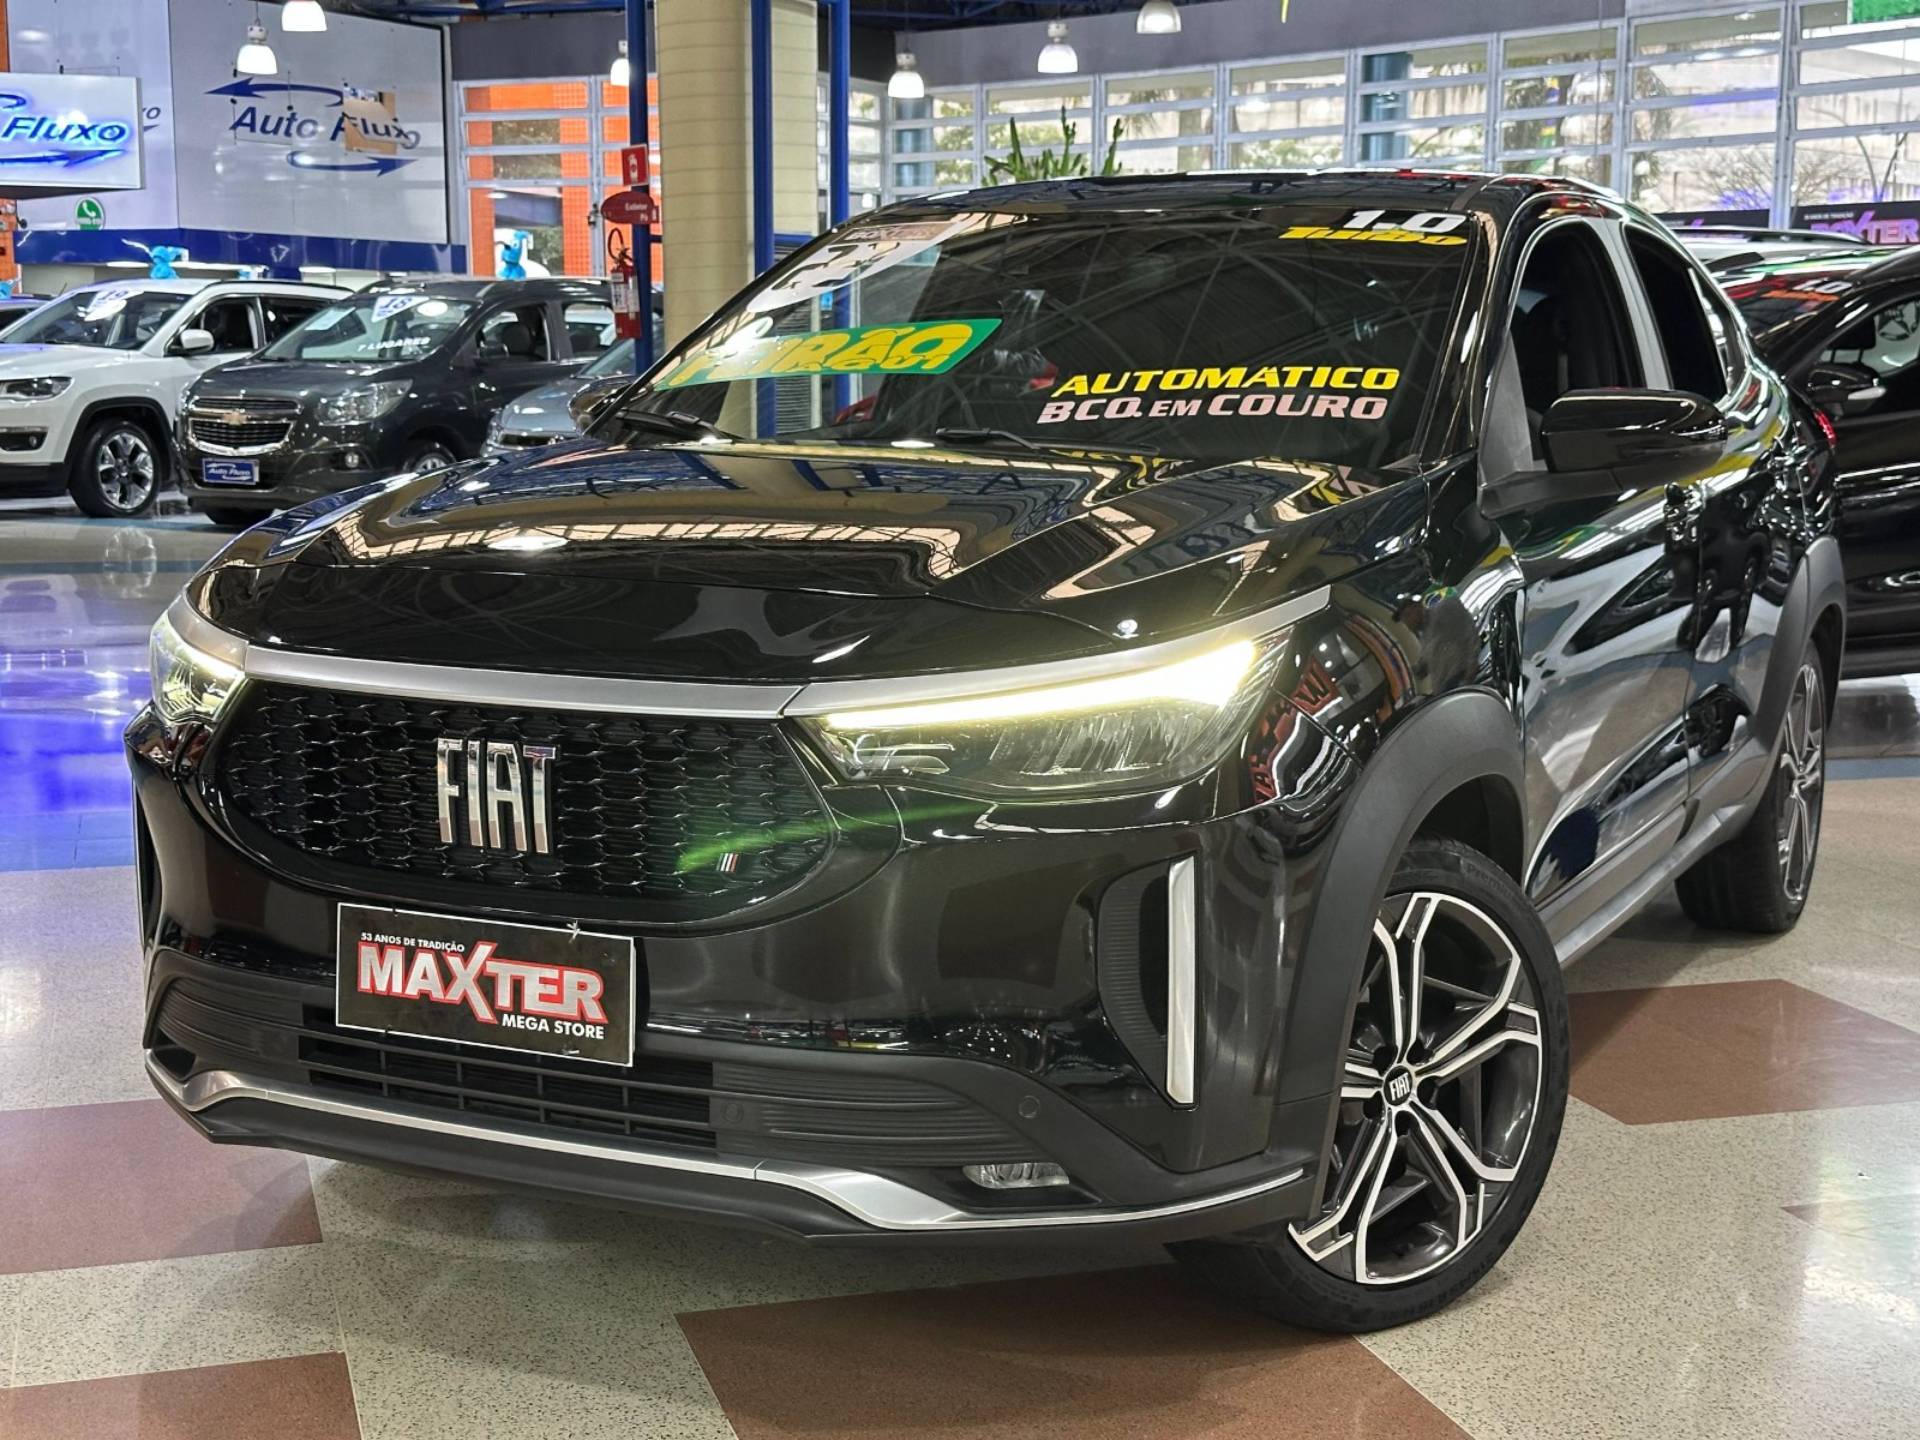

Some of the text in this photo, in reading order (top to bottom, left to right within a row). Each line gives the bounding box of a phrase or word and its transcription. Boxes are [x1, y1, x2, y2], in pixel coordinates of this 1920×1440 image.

[1, 116, 126, 141] Fluxo
[228, 106, 421, 150] Auto Fluxo
[1343, 209, 1467, 233] 1.0
[1149, 399, 1202, 417] EM
[1207, 394, 1389, 420] COURO
[437, 737, 556, 854] FIAT
[361, 932, 466, 953] 53 ANOS DE TRADIÇÃO
[357, 940, 609, 1025] MAXTER
[502, 1013, 605, 1040] MEGA STORE
[1389, 1071, 1410, 1102] FIAT
